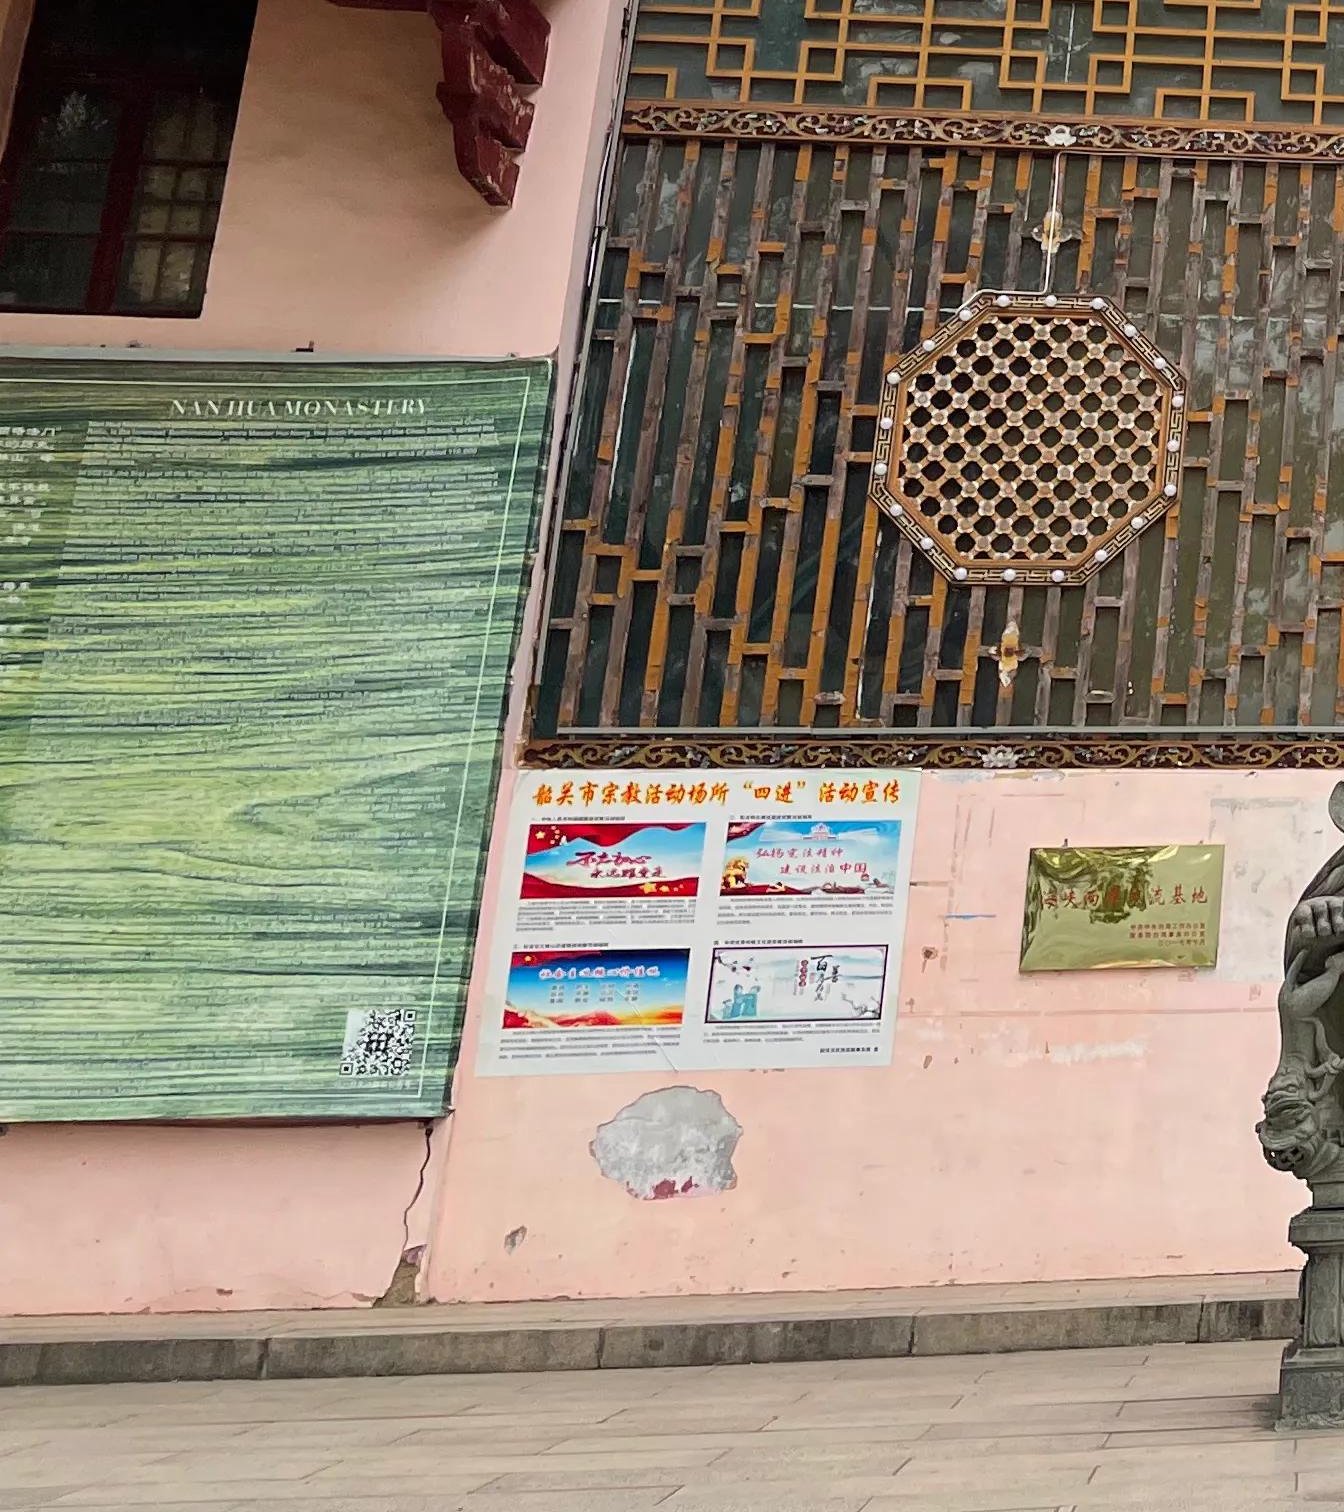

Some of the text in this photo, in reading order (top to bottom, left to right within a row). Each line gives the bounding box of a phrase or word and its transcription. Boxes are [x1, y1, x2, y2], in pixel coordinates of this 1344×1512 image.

[171, 399, 426, 416] NAN HUA MONASTERY
